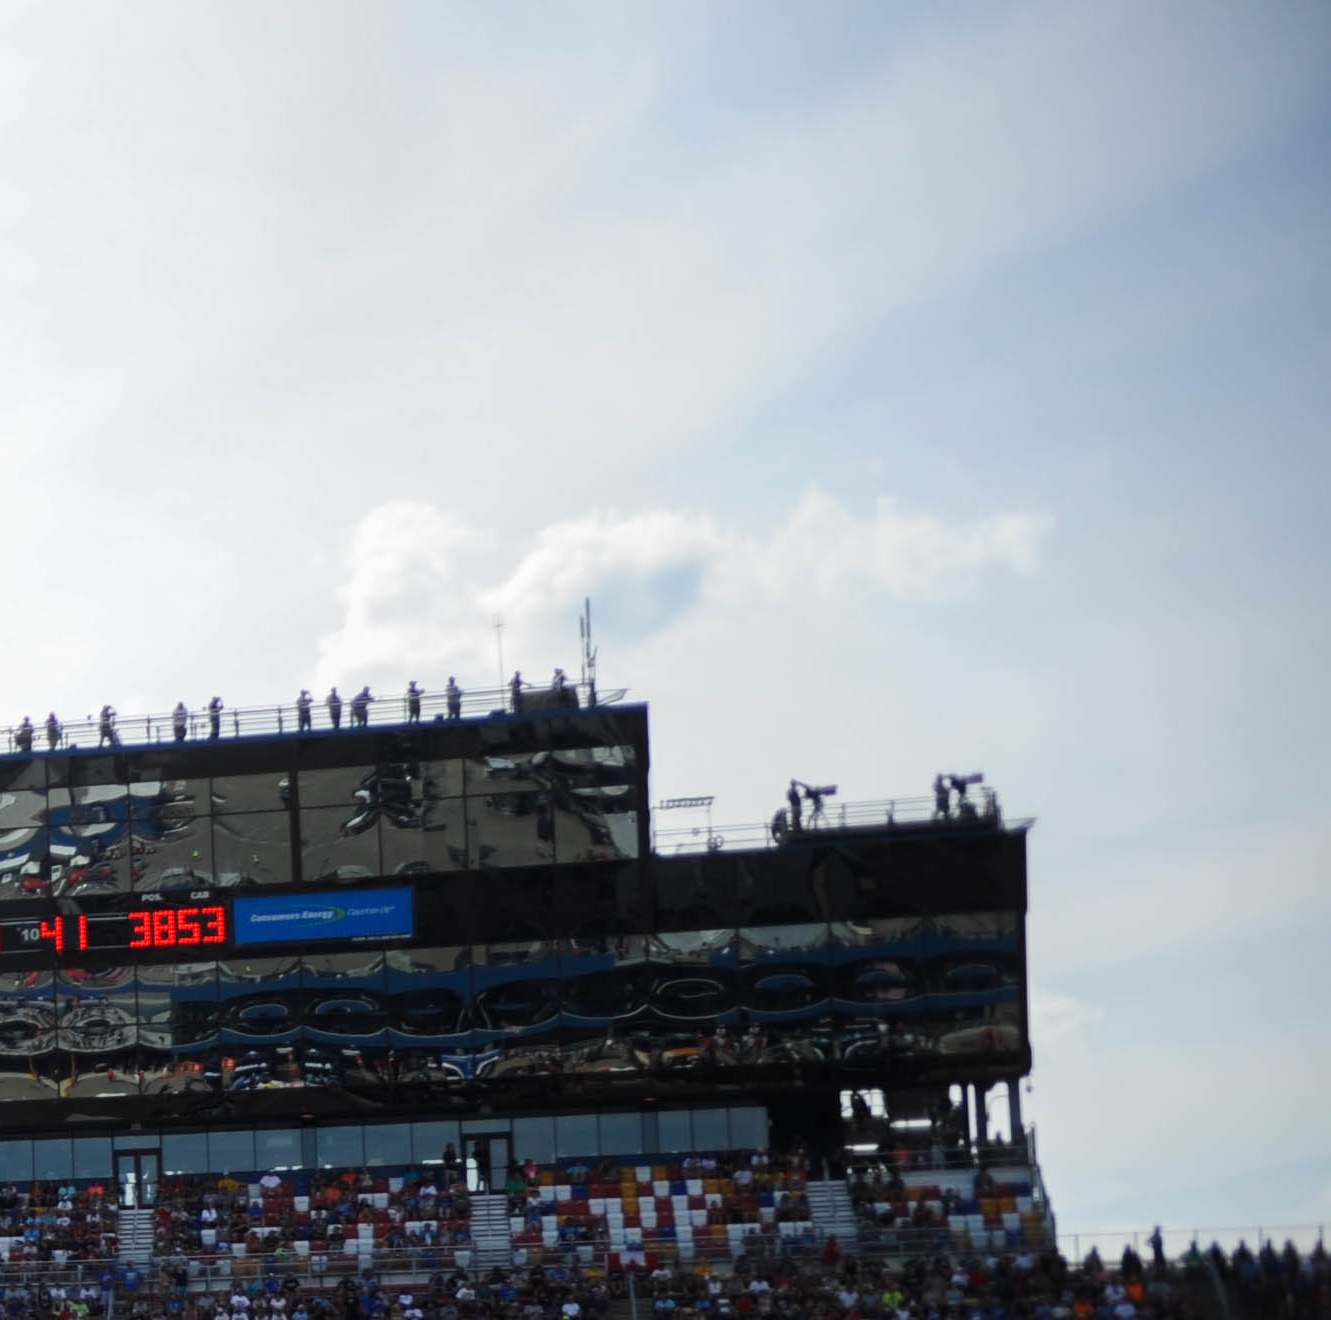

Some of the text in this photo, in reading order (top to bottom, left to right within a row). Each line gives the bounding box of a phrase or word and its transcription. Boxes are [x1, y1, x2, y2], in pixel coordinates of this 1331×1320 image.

[190, 890, 210, 900] CAR
[250, 911, 300, 922] Consumers
[302, 909, 334, 921] Energy
[22, 915, 88, 951] 10 41
